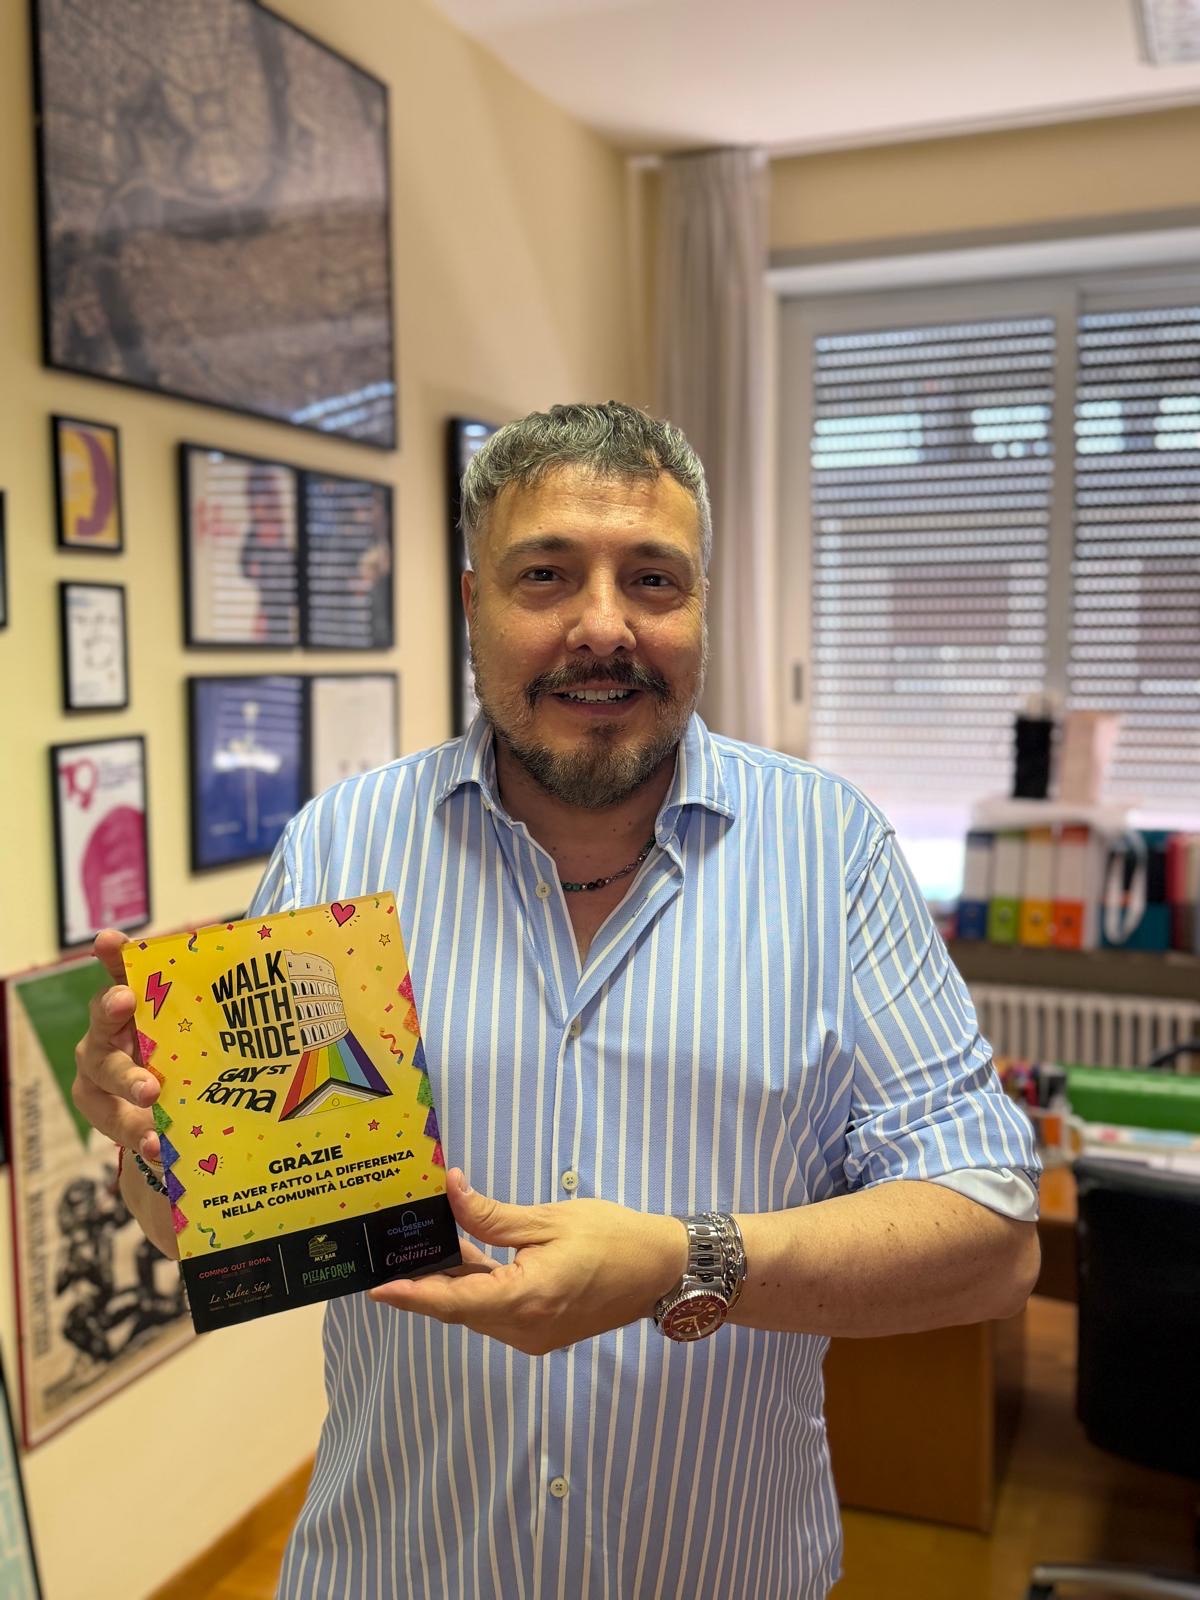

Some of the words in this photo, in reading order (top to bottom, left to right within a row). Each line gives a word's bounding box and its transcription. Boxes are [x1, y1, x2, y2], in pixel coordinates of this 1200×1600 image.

[211, 950, 287, 1003] WALK
[222, 986, 292, 1029] WITH
[219, 1022, 300, 1059] PRIDE
[197, 1082, 277, 1113] Roma
[268, 1145, 344, 1174] GRAZIE
[202, 1195, 229, 1208] PER
[232, 1186, 268, 1202] AVER
[271, 1174, 312, 1194] FATTO
[316, 1169, 333, 1181] LA
[336, 1150, 415, 1176] DIFFERENZA
[221, 1202, 264, 1219] NELLA
[267, 1181, 337, 1207] COMUNITÀ
[339, 1167, 401, 1190] LGBTQIA+
[387, 1219, 434, 1236] COLOSSEUM
[231, 1262, 246, 1271] OUT
[248, 1256, 272, 1267] ROMA
[302, 1260, 357, 1285] PIZZAFORUM
